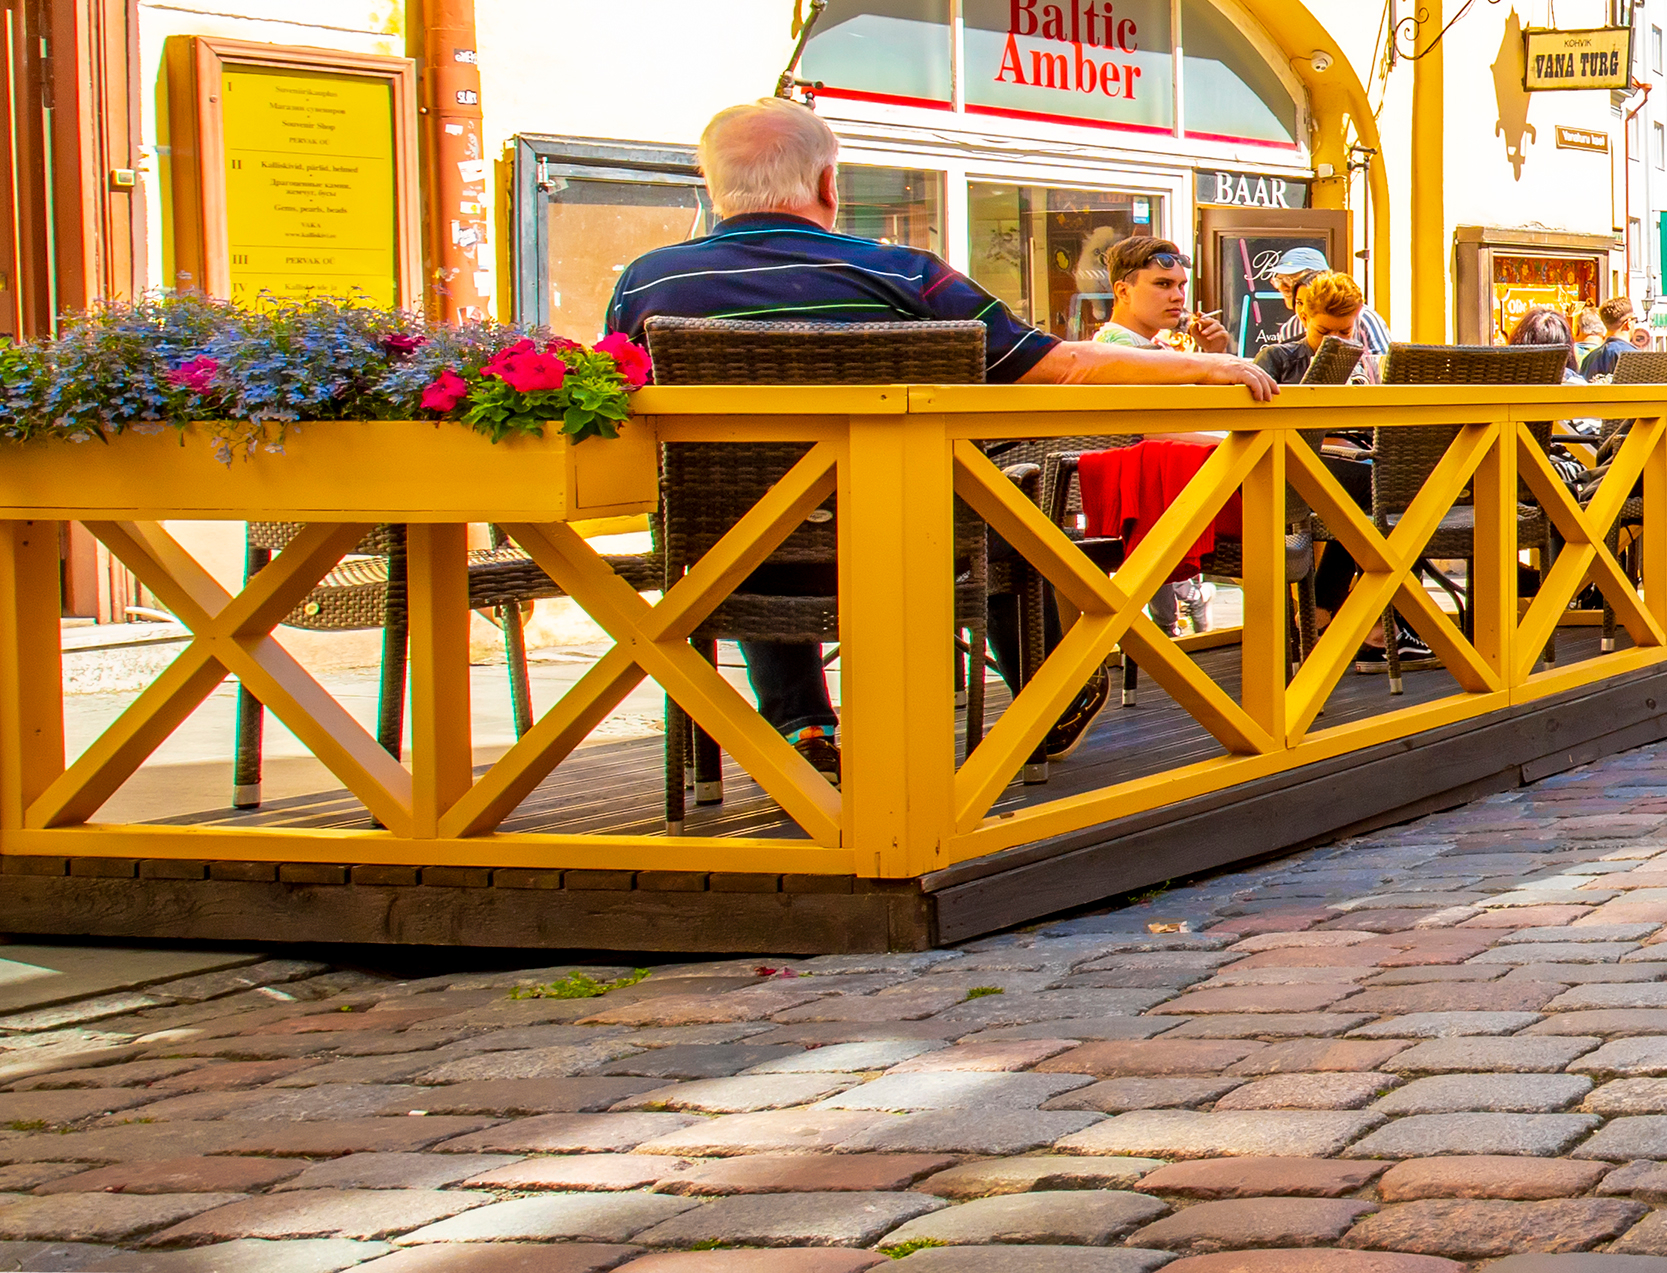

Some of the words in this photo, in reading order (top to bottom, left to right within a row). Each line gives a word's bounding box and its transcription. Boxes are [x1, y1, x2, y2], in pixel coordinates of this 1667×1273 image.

[1564, 38, 1592, 48] KOHVIK
[993, 32, 1142, 100] Amber
[1535, 52, 1575, 79] VANA
[1580, 50, 1620, 78] TURG
[317, 121, 336, 132] Shop
[1214, 171, 1290, 208] BAAR
